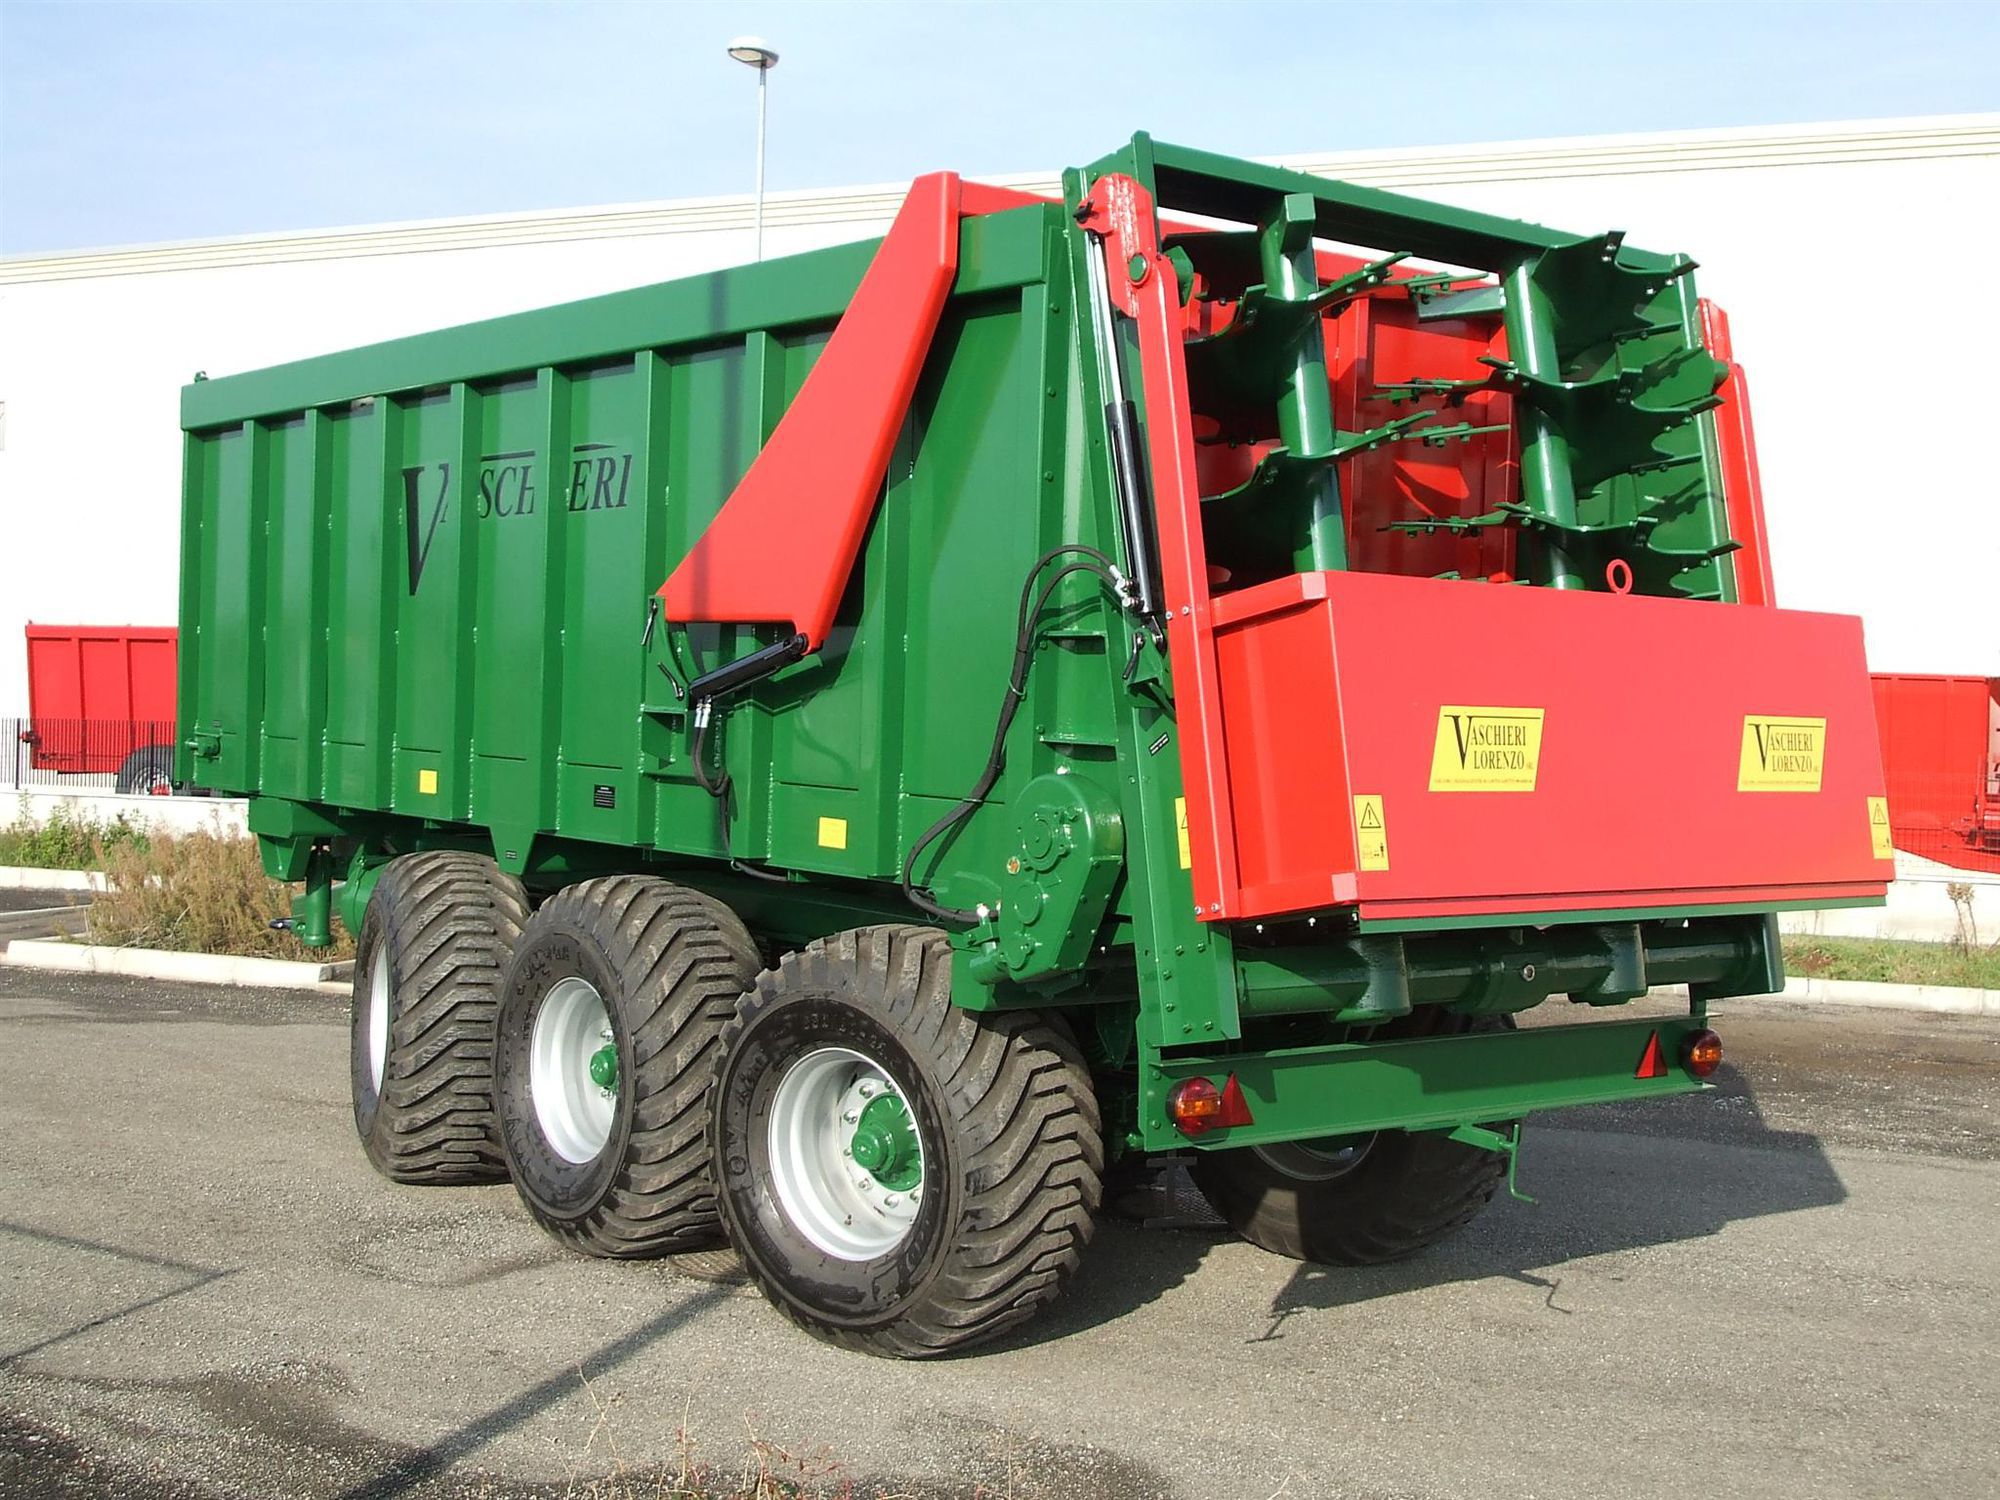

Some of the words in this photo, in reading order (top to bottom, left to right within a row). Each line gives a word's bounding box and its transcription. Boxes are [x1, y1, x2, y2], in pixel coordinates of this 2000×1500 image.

[401, 454, 633, 597] VSCHERI
[1451, 715, 1527, 770] VASCHIERI
[1473, 750, 1525, 770] LORENZO
[1754, 724, 1814, 772] VASCHIERI
[1772, 755, 1813, 772] LORENZO
